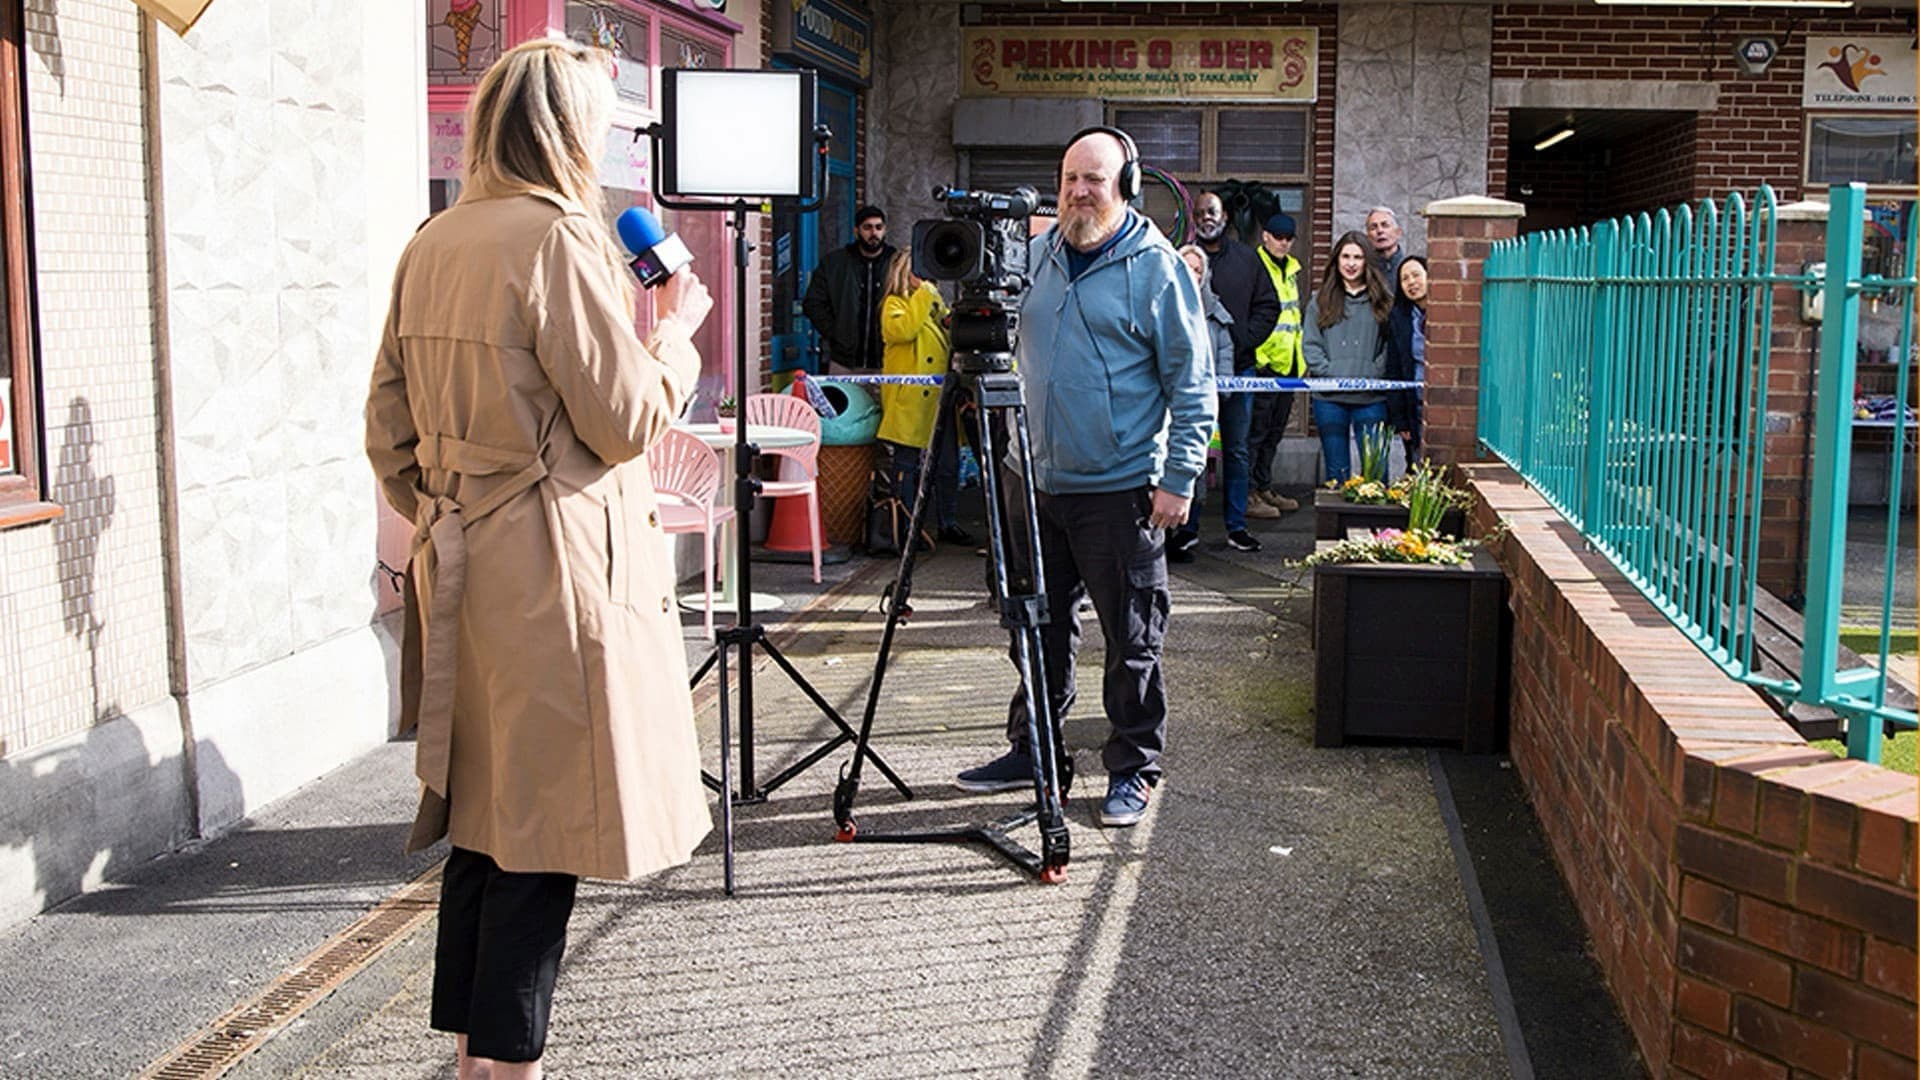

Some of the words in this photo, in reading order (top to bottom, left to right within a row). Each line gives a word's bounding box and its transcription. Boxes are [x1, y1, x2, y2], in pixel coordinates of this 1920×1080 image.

[1001, 38, 1138, 69] PEKING
[1147, 39, 1273, 69] ODER
[1016, 73, 1041, 82] FISH
[1055, 73, 1083, 82] CHIPS
[1098, 73, 1141, 82] CHINESE
[1146, 73, 1179, 82] MEALS
[1184, 73, 1197, 82] TO
[1200, 73, 1225, 83] TAKE
[1228, 73, 1259, 83] AWAY
